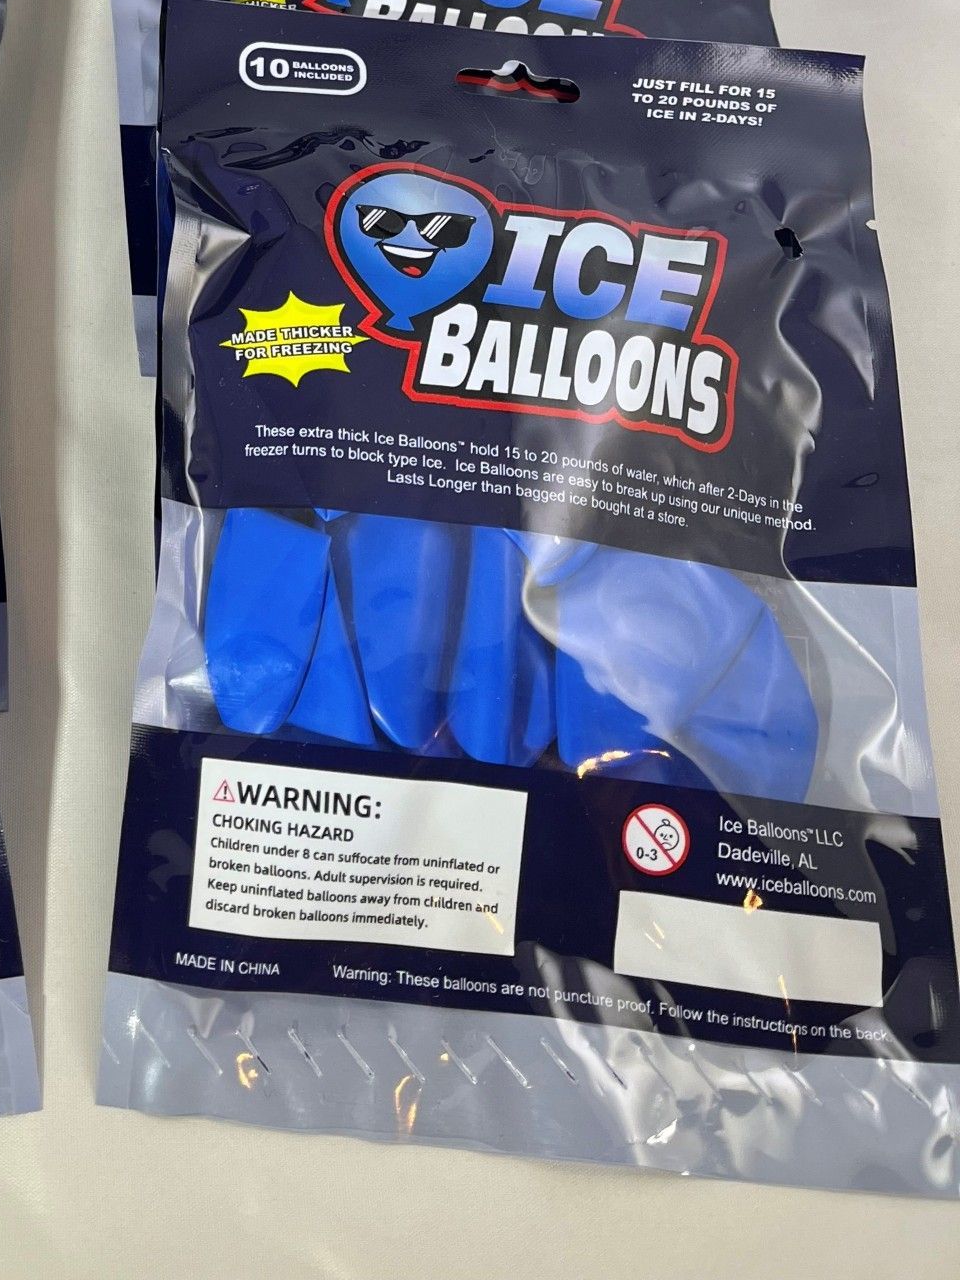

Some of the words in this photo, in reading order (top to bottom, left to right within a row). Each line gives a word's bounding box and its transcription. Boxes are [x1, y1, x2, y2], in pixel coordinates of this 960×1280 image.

[249, 57, 290, 79] 10
[293, 61, 355, 74] BALLOONS
[294, 72, 353, 83] INCLUDED
[632, 77, 677, 91] JUST
[679, 81, 715, 95] FILL
[718, 84, 752, 97] FOR
[756, 87, 776, 99] 15
[631, 92, 654, 104] TO
[657, 95, 678, 106] 20
[682, 96, 751, 111] POUNDS
[755, 102, 778, 113] OF
[646, 108, 675, 120] ICE
[678, 110, 697, 121] IN
[701, 112, 763, 127] 2-DAYS!
[482, 214, 707, 332] ICE
[230, 331, 277, 346] MADE
[280, 325, 354, 341] THICKER
[235, 346, 269, 361] FOR
[271, 341, 354, 358] FREEZING
[419, 303, 724, 436] BALLOONS
[237, 782, 382, 820] WARNING:
[212, 813, 282, 835] CHOKING
[287, 822, 354, 842] HAZARD
[210, 837, 260, 853] Children
[263, 845, 300, 858] under
[302, 848, 310, 860] 8
[313, 851, 335, 862] can
[337, 852, 391, 866] suffocate
[393, 854, 420, 866] from
[423, 857, 485, 873] uninflated
[487, 865, 500, 874] or
[636, 846, 659, 862] 0-3
[718, 843, 795, 870] Dadeville,
[798, 852, 818, 870] AL
[716, 873, 877, 904] www.iceballoons.com
[175, 952, 216, 971] MADE
[220, 959, 235, 974] IN
[238, 961, 280, 975] CHINA
